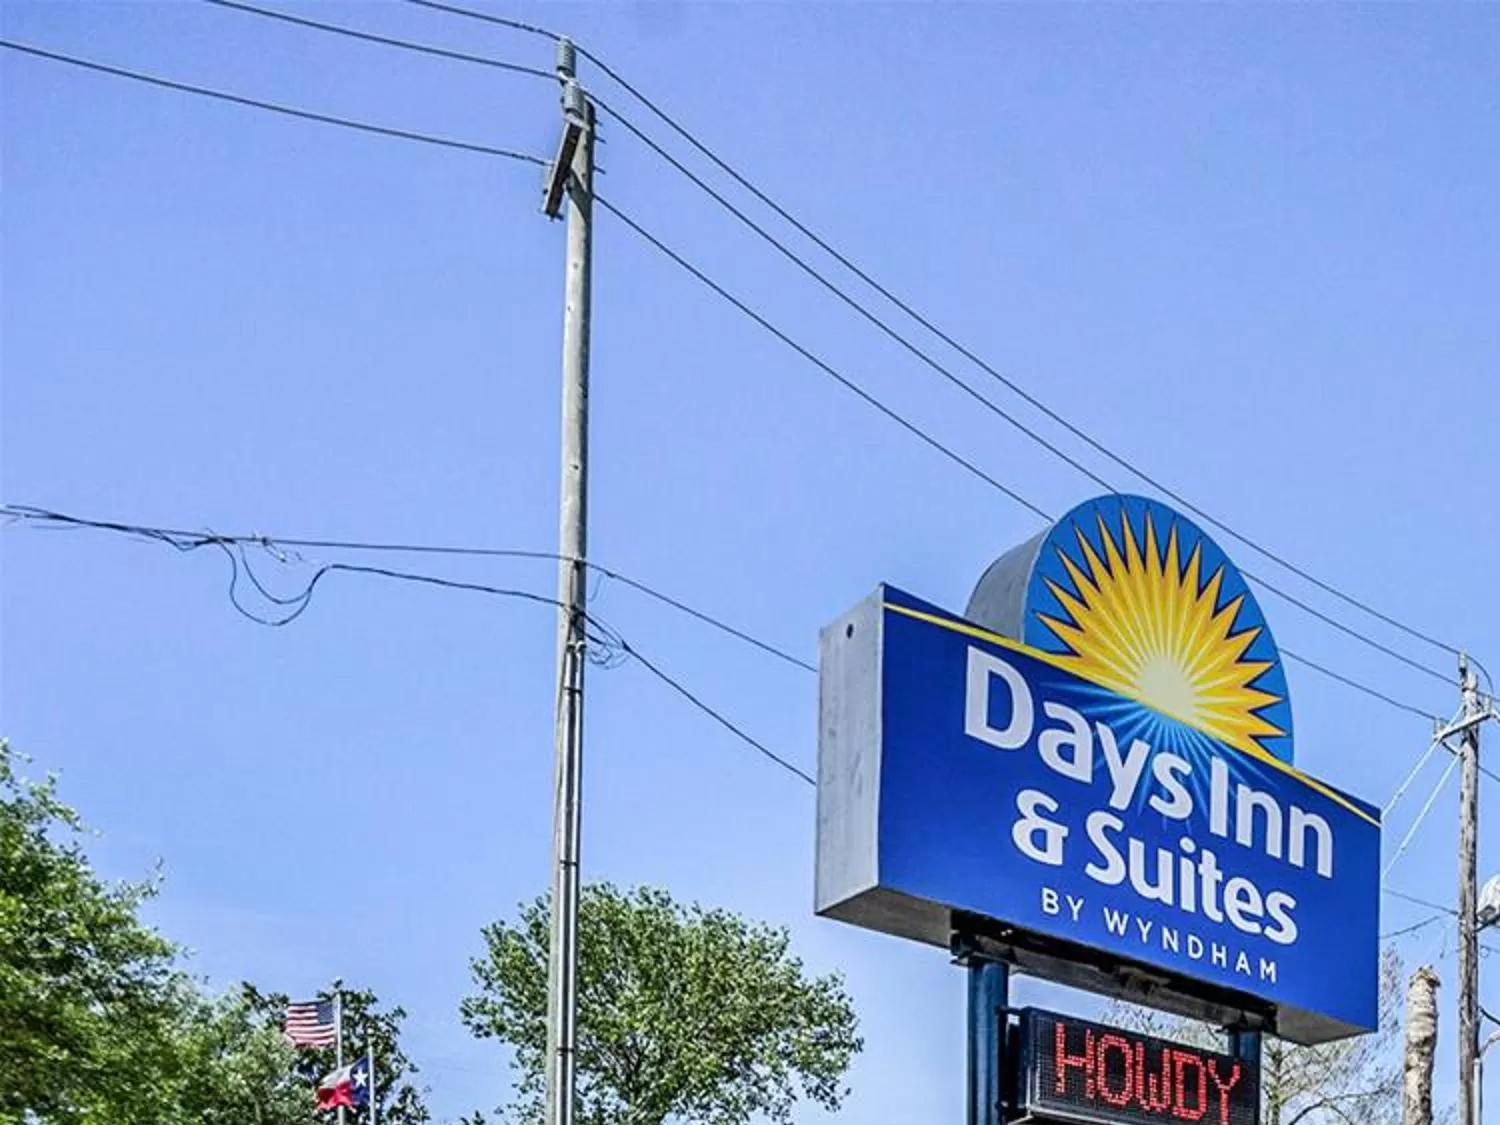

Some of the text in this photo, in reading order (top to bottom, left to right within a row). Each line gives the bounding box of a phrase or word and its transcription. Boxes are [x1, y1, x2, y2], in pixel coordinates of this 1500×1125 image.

[964, 644, 1333, 879] Days Inn
[1011, 788, 1298, 945] & Suites
[1041, 886, 1278, 984] BY WYNDHAM
